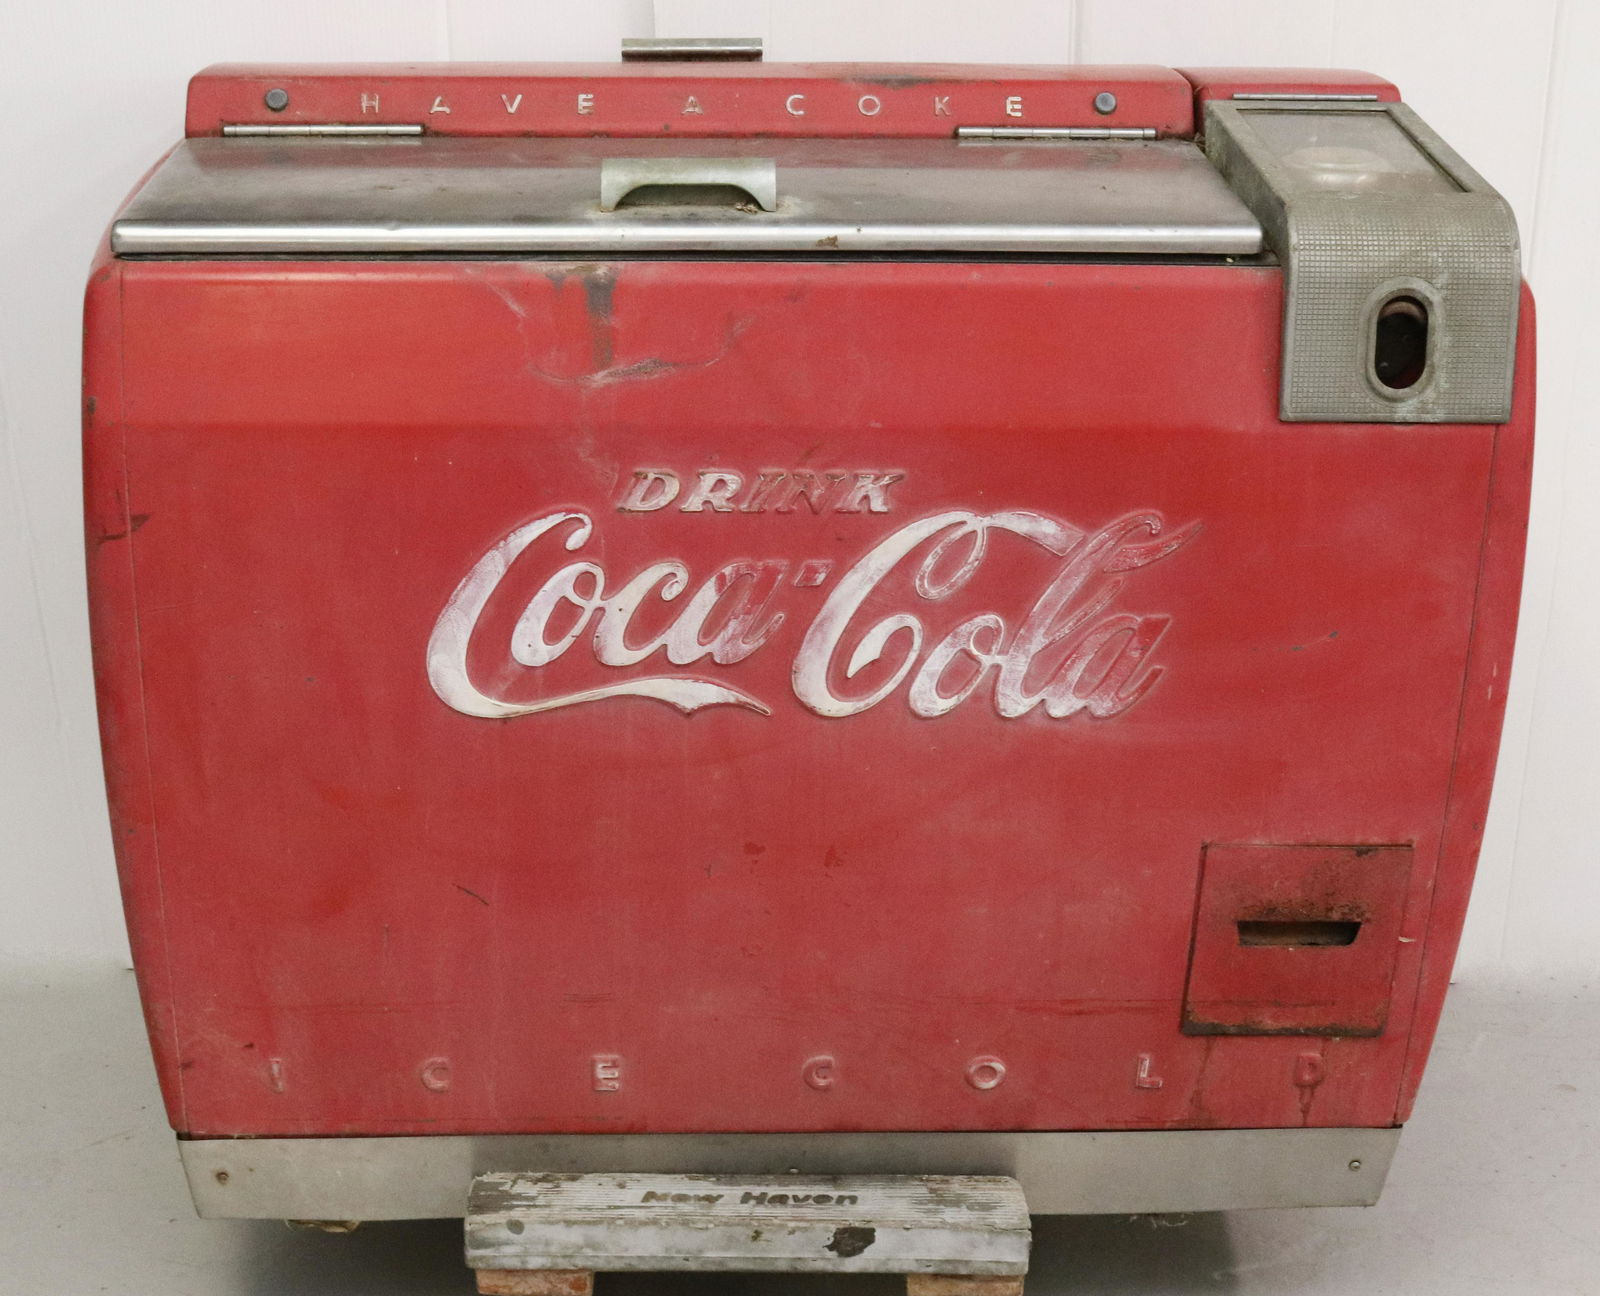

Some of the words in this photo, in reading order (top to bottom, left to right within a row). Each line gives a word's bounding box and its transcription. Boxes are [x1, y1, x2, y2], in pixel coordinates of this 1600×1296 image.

[360, 93, 595, 115] HAVE
[682, 95, 704, 114] A
[785, 93, 1023, 119] COKE
[616, 466, 904, 513] DRINK
[426, 508, 1200, 719] Coca-Cola
[269, 1053, 622, 1093] ICE
[803, 1053, 1325, 1090] COLD
[641, 1190, 725, 1204] New
[739, 1190, 859, 1205] Haven
